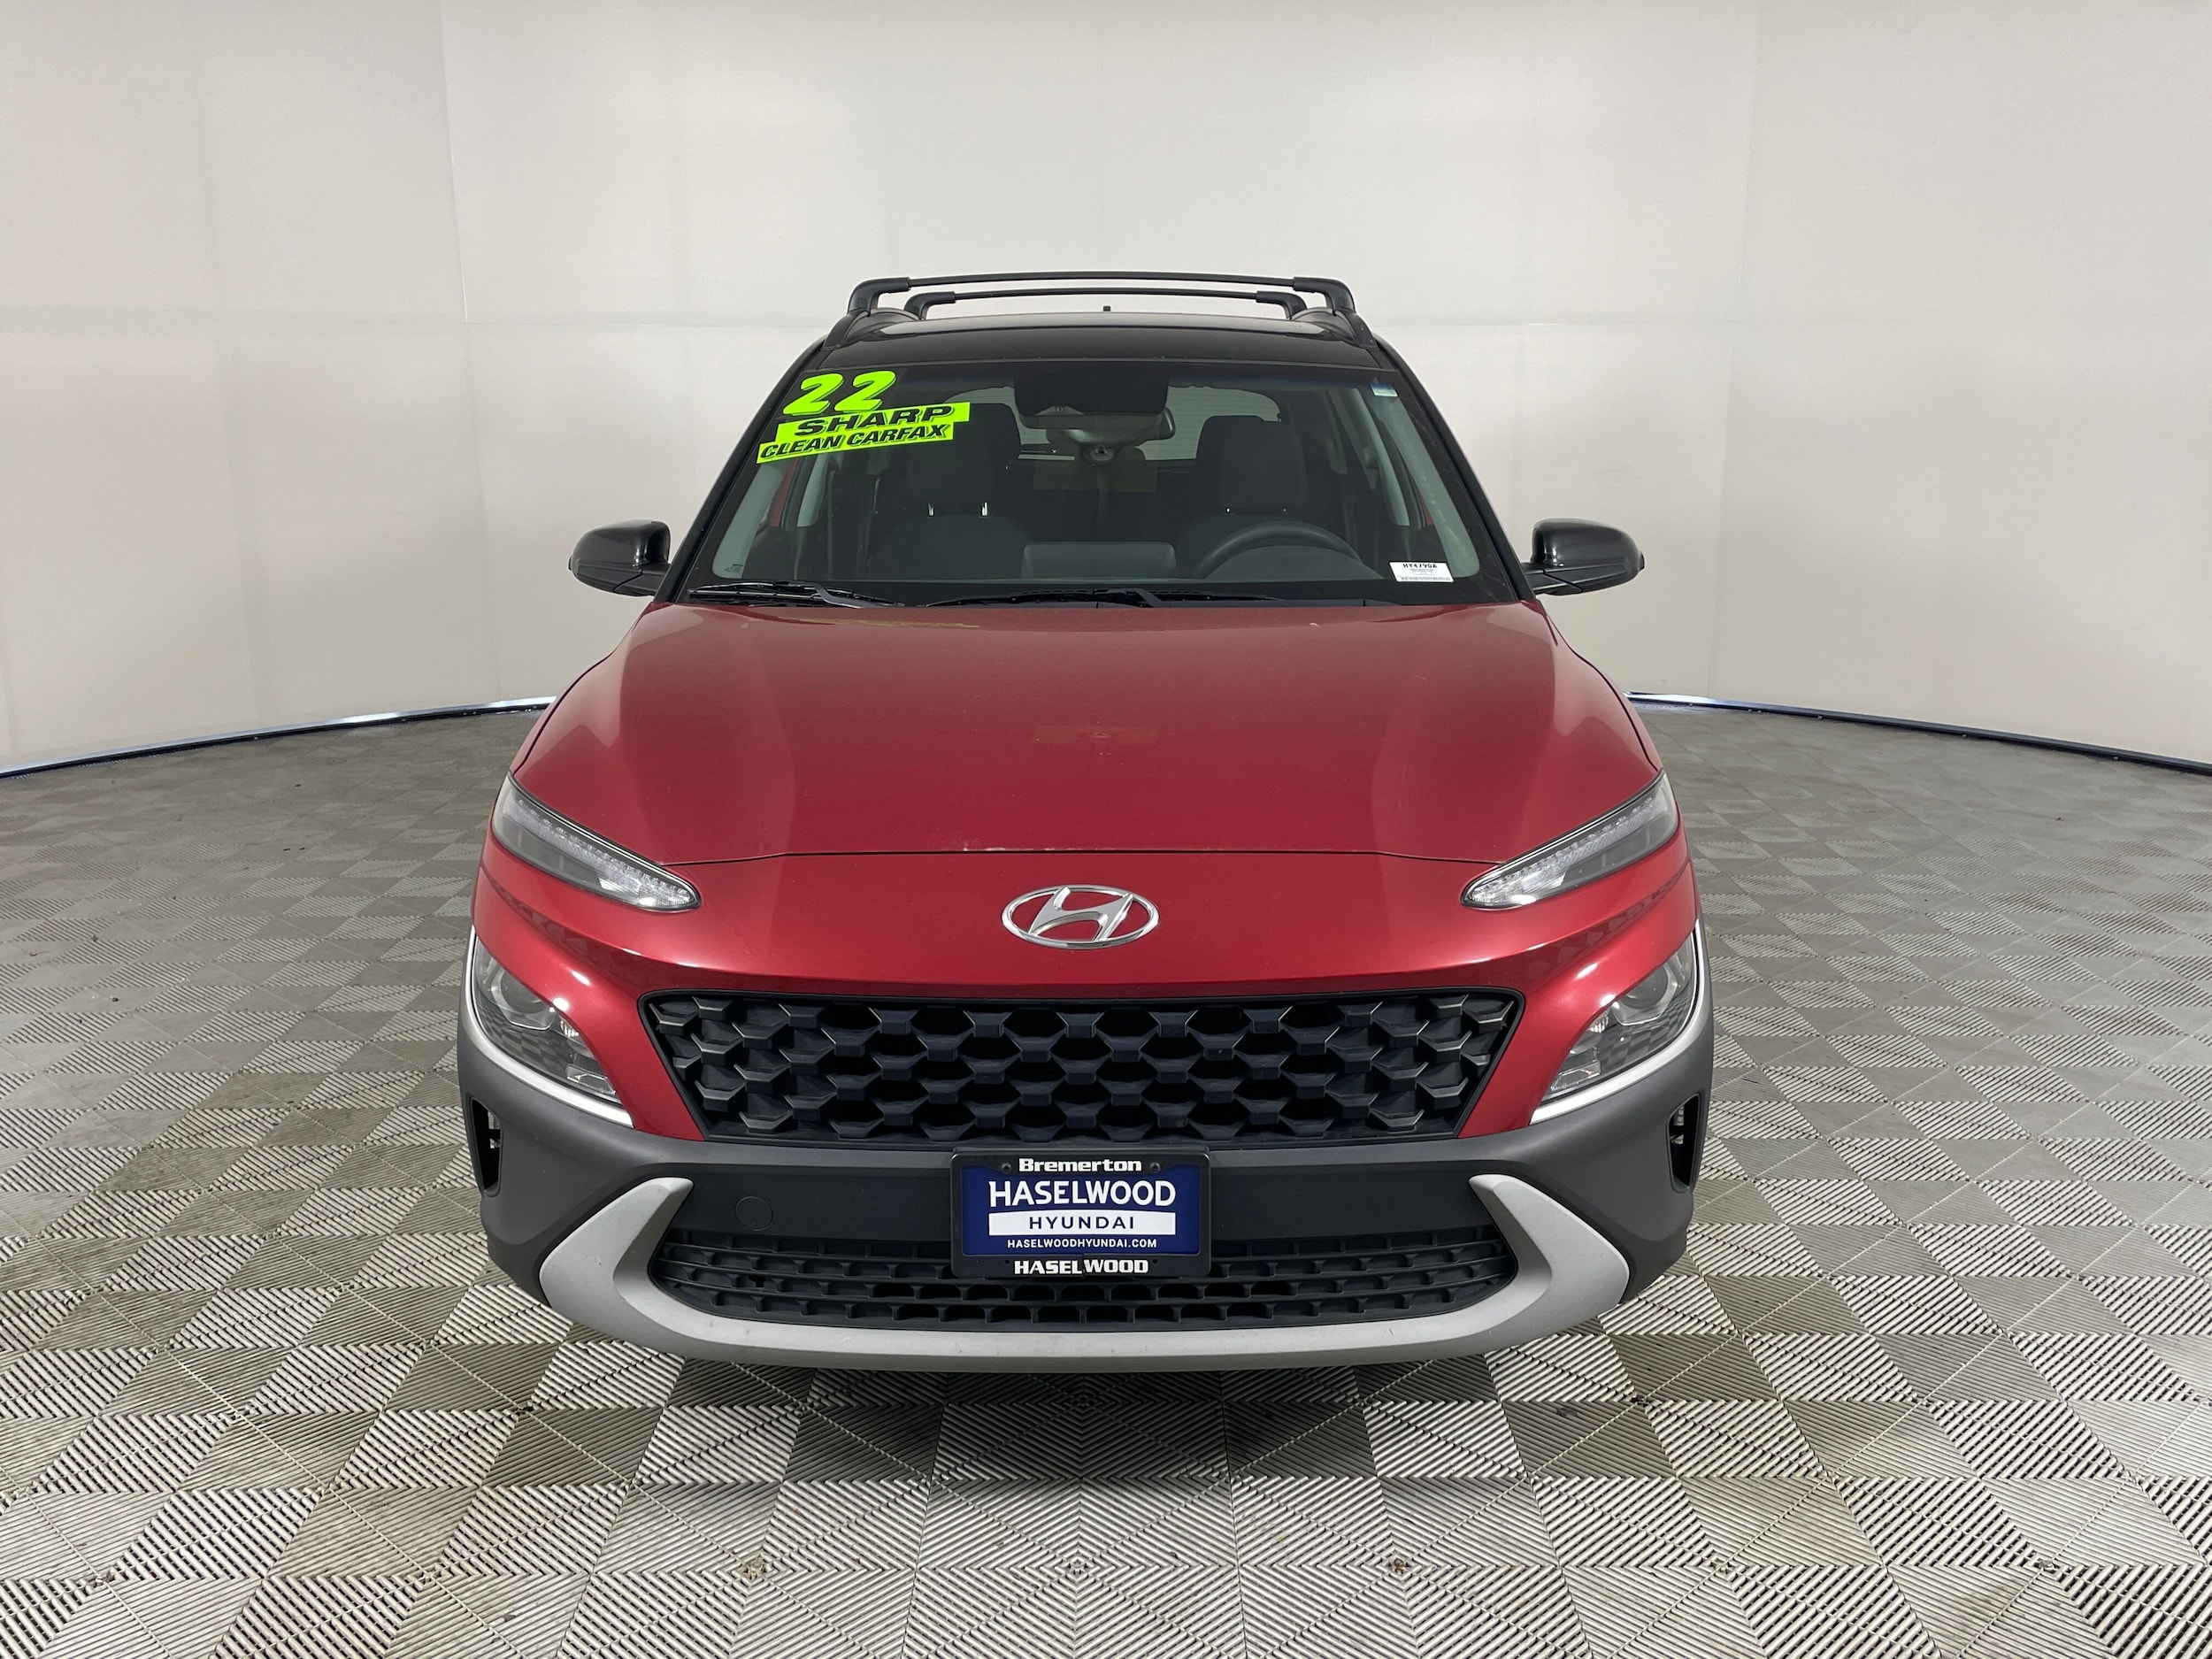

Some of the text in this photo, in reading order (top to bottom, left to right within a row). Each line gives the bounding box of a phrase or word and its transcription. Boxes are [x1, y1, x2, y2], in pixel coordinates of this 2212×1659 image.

[783, 371, 897, 416] 22
[795, 405, 956, 436] SHARP
[759, 423, 951, 459] CLEAN CARFAX
[1018, 1157, 1142, 1172] Bremerton
[988, 1179, 1177, 1207] HASELWOOD
[1028, 1216, 1135, 1229] HYUNDAI
[1007, 1239, 1157, 1248] HASELWOODHYUNDAI.COM
[1013, 1259, 1148, 1274] HASELWOOD
